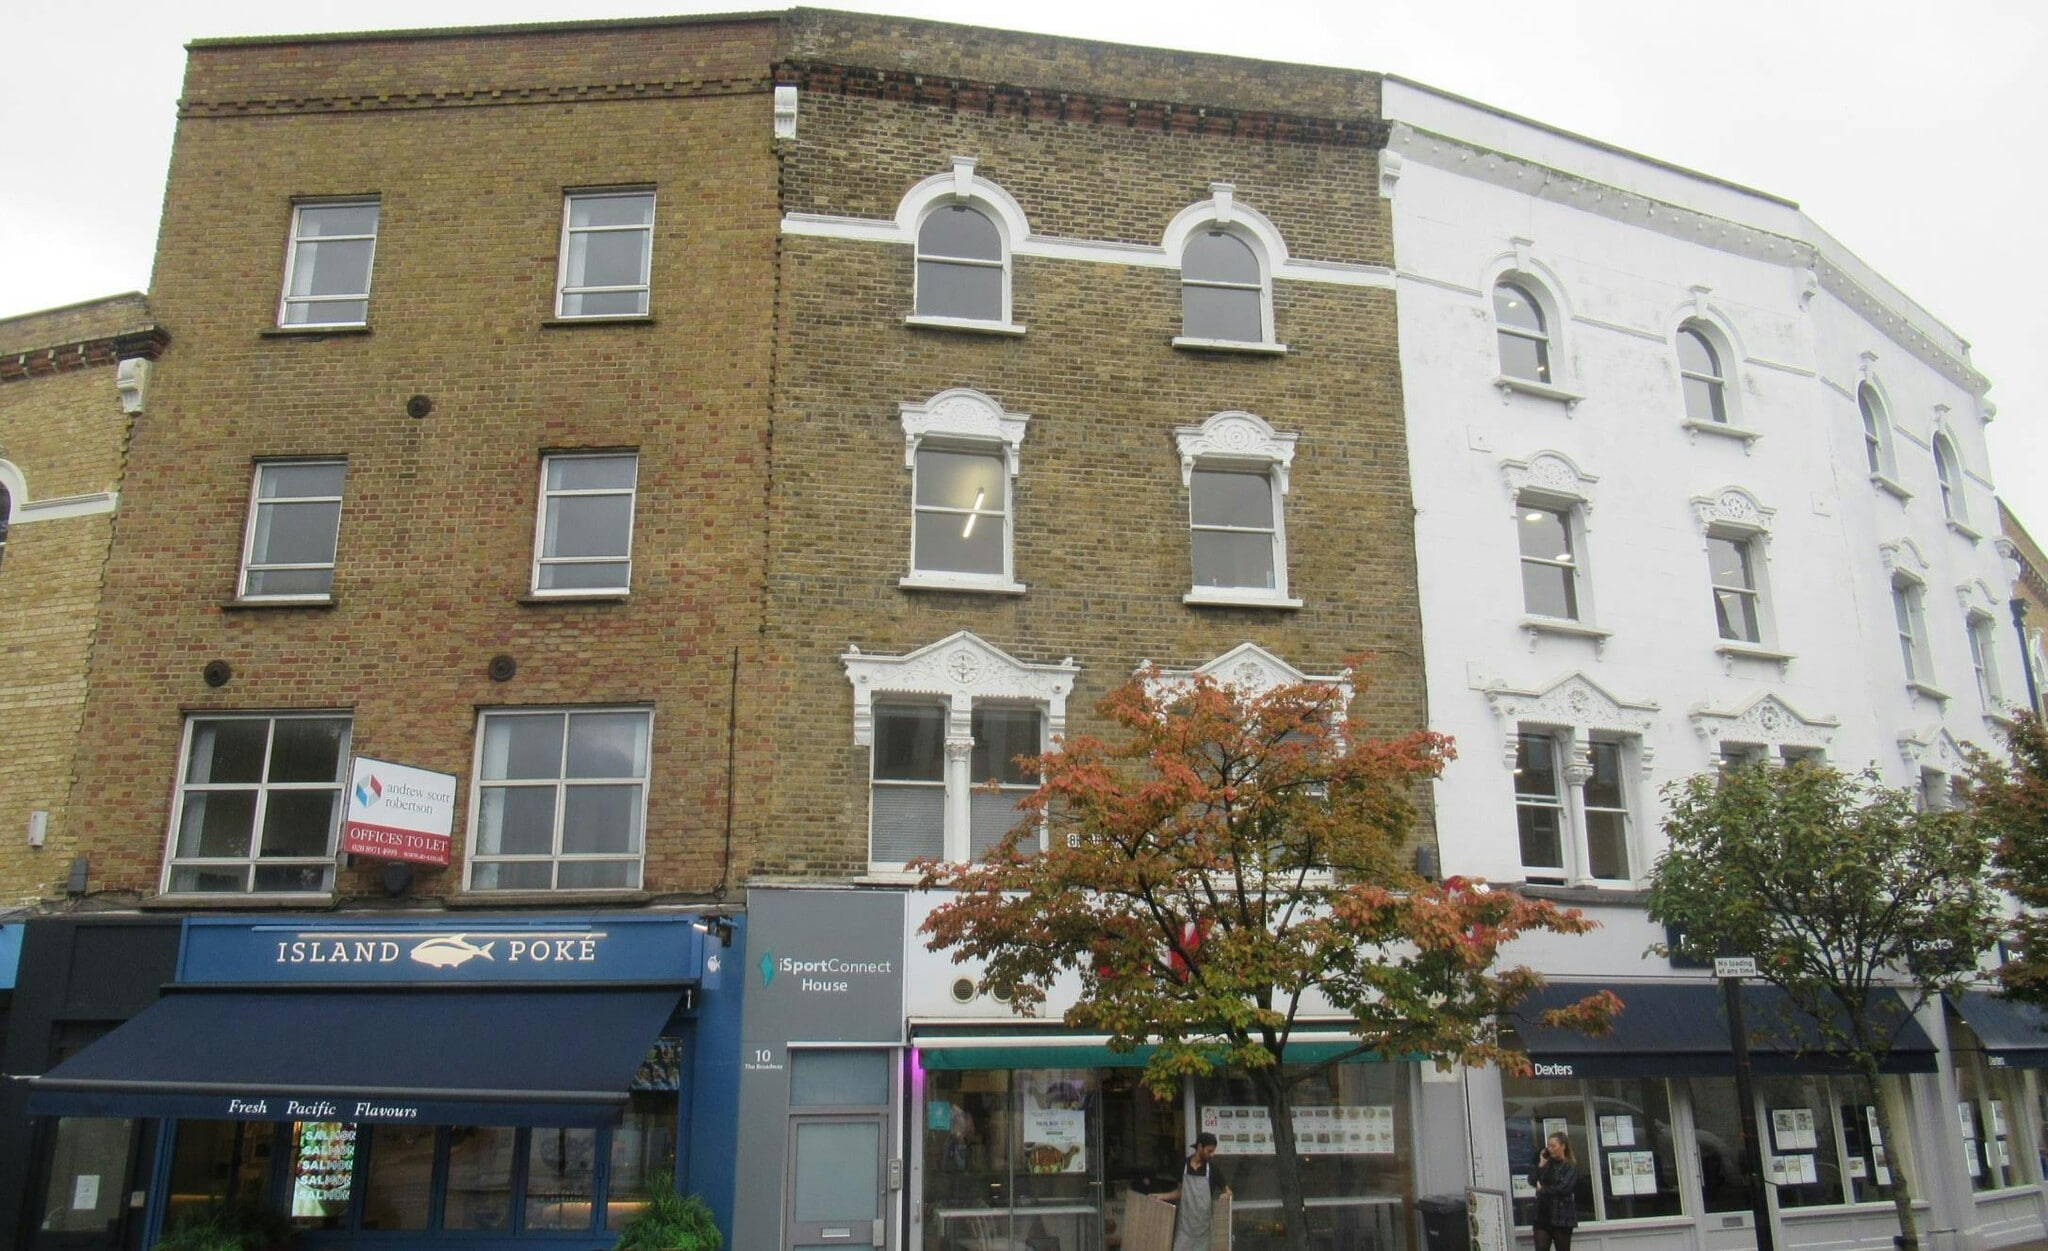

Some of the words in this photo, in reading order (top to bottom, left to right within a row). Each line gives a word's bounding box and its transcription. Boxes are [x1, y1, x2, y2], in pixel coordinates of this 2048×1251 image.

[387, 783, 424, 798] andrew
[427, 791, 451, 803] scott
[385, 798, 434, 814] robertson
[350, 828, 403, 845] OFFICES
[405, 835, 424, 848] TO
[426, 837, 448, 852] LET
[277, 941, 400, 963] ISLAND
[508, 934, 597, 961] POKÉ
[779, 958, 892, 974] iSportConnect
[802, 978, 848, 992] House
[755, 1049, 771, 1062] 10
[756, 1063, 784, 1071] Broadway
[1534, 1063, 1573, 1076] Dexters
[228, 1099, 268, 1114] Fresh
[286, 1100, 337, 1117] Pacific
[354, 1102, 418, 1118] Flavours
